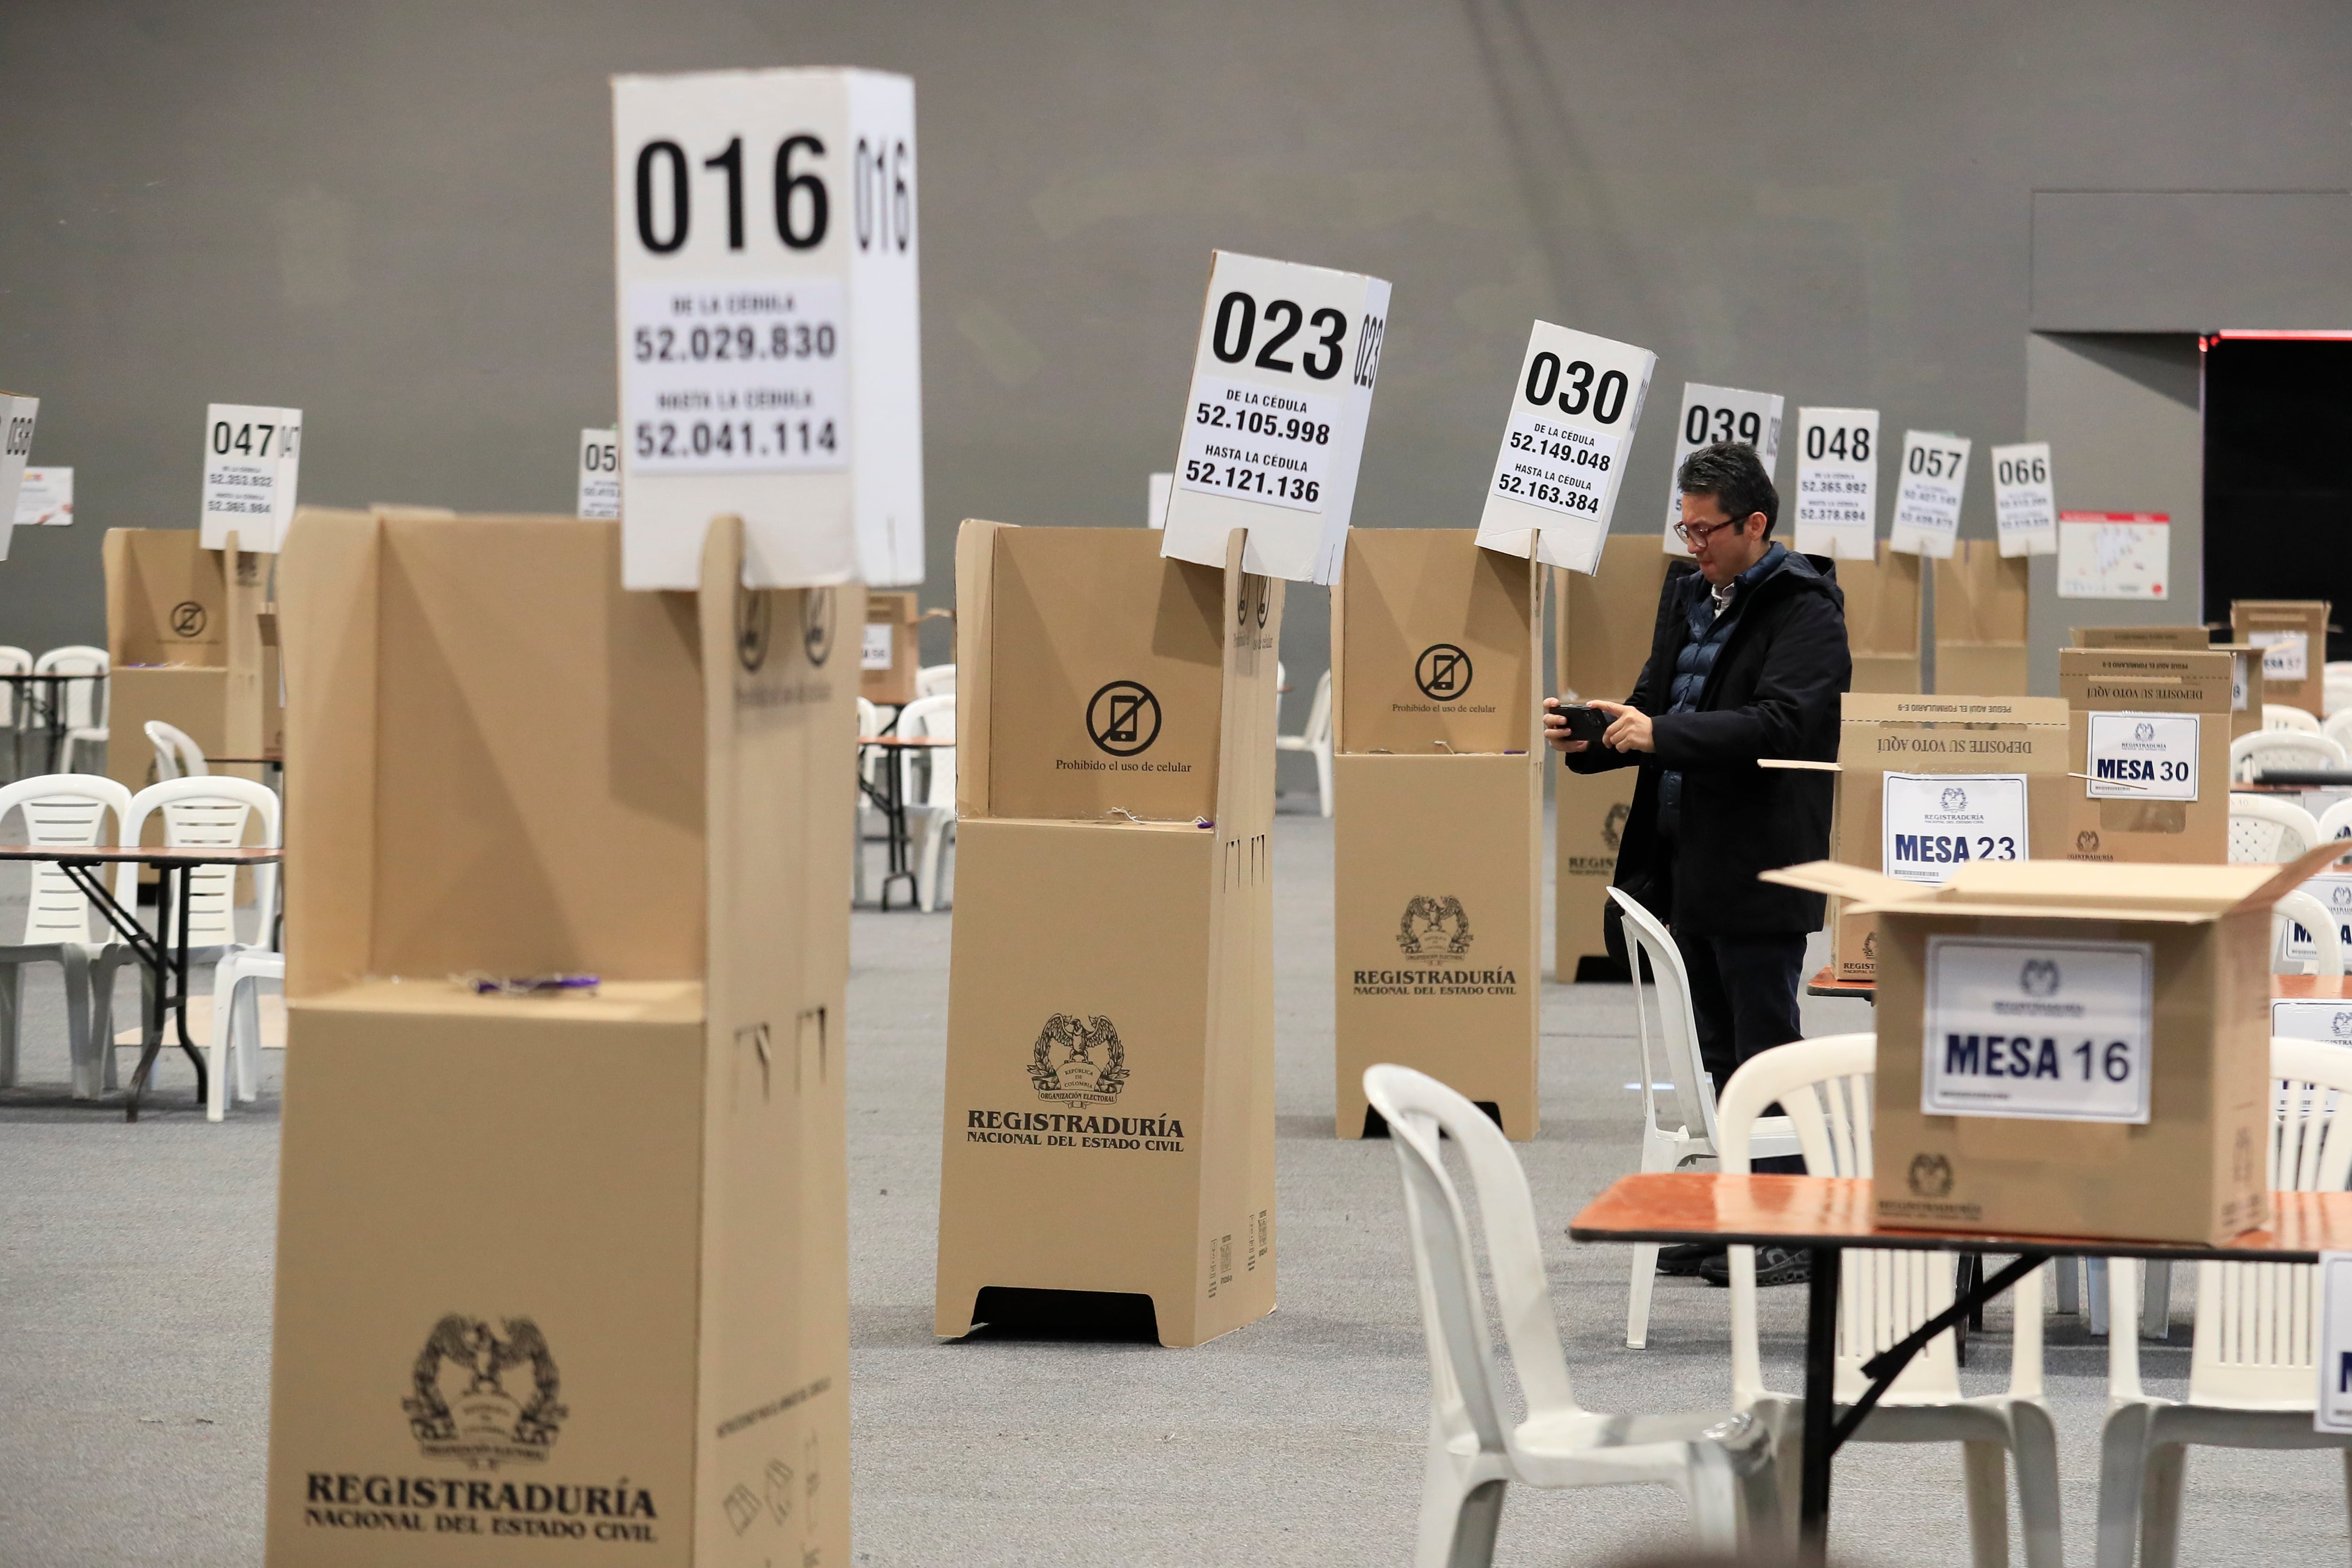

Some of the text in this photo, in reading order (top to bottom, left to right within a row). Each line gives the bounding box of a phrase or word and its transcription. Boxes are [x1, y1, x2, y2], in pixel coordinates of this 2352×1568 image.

[635, 133, 830, 254] 016
[854, 136, 910, 253] 016
[635, 324, 837, 362] 52.029.830
[1213, 291, 1347, 380] 023
[1354, 314, 1383, 390] 023
[1226, 390, 1308, 414] DE LA CÉDULA
[1525, 351, 1629, 424] 030
[214, 421, 275, 457] 047
[636, 418, 837, 458] 52.041.114
[1197, 403, 1330, 446] 52.105.998
[1534, 423, 1595, 447] DE LA CÉDULA
[1685, 405, 1761, 447] 039
[585, 444, 621, 472] 05
[1510, 431, 1611, 471] 52.149.048
[1807, 425, 1870, 462] 048
[1205, 444, 1308, 473] HASTA LA CÉDULA
[1909, 447, 1962, 480] 057
[1999, 458, 2046, 485] 066
[1185, 460, 1320, 503] 52.121.136
[1515, 463, 1592, 491] HASTA LA CÉDULA
[1498, 473, 1599, 513] 52.163.384
[2113, 688, 2138, 698] VOTO
[2141, 689, 2153, 699] SU
[2156, 689, 2203, 700] DEPOSITE
[1392, 704, 1430, 712] Prohibido
[1911, 704, 1957, 713] FORMULARIO
[1878, 736, 2032, 754] DEPOSITE SU VOTO AQUÍ
[1056, 759, 1106, 771] Prohibido
[1109, 761, 1118, 771] el
[1141, 762, 1153, 771] de
[1157, 762, 1192, 772] celular
[2097, 759, 2189, 781] MESA 30
[1896, 834, 2016, 863] MESA 23
[1354, 966, 1517, 984] REGISTRADURÍA
[1487, 987, 1517, 995] CIVIL
[1065, 1068, 1093, 1076] REPÚBLICA
[1945, 1034, 2130, 1082] MESA 16
[1083, 1093, 1115, 1102] ELECTORAL
[968, 1110, 1184, 1138] REGISTRADURÍA
[967, 1131, 1184, 1152] NACIONAL DEL ESTADO CIVIL
[306, 1472, 658, 1520] REGISTRADURÍA
[305, 1508, 658, 1543] NACIONAL DEL ESTADO CIVIL
